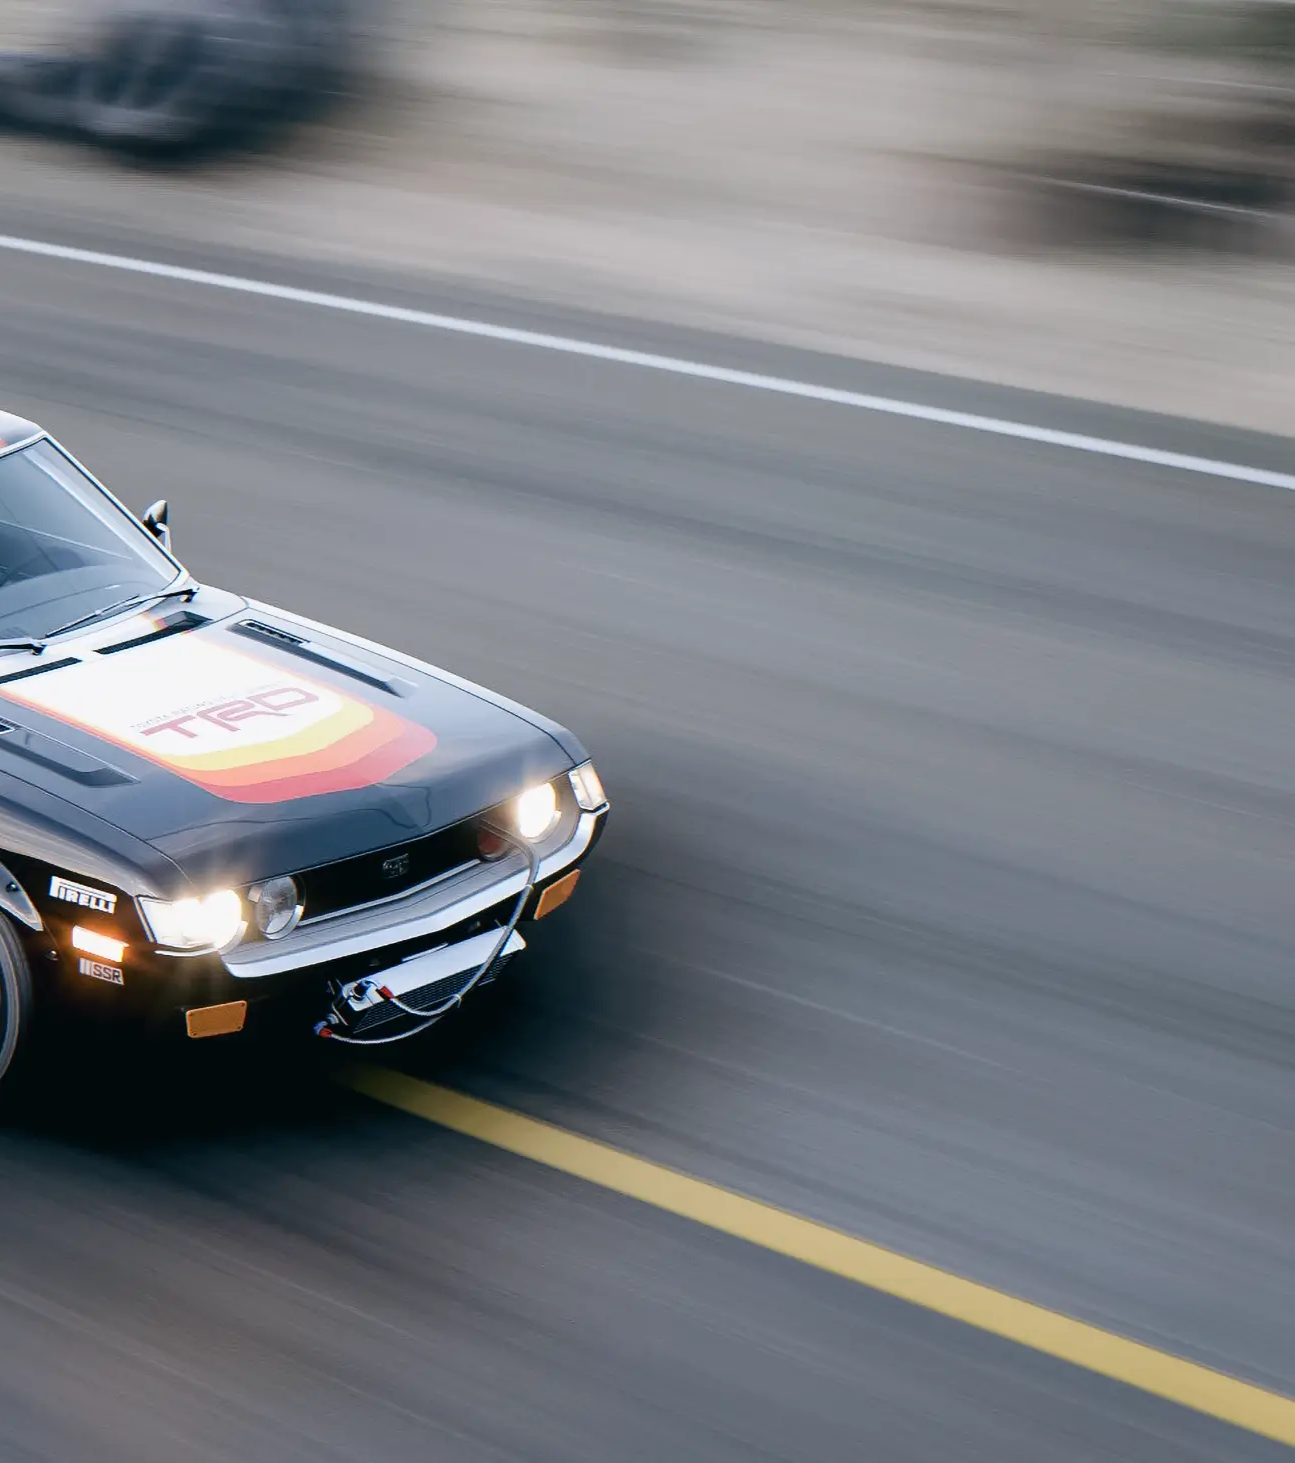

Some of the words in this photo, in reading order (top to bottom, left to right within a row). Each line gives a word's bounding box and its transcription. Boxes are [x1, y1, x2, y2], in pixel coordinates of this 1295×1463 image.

[140, 687, 319, 739] TRD
[49, 875, 118, 914] PIRELLI
[91, 962, 123, 984] SSR
